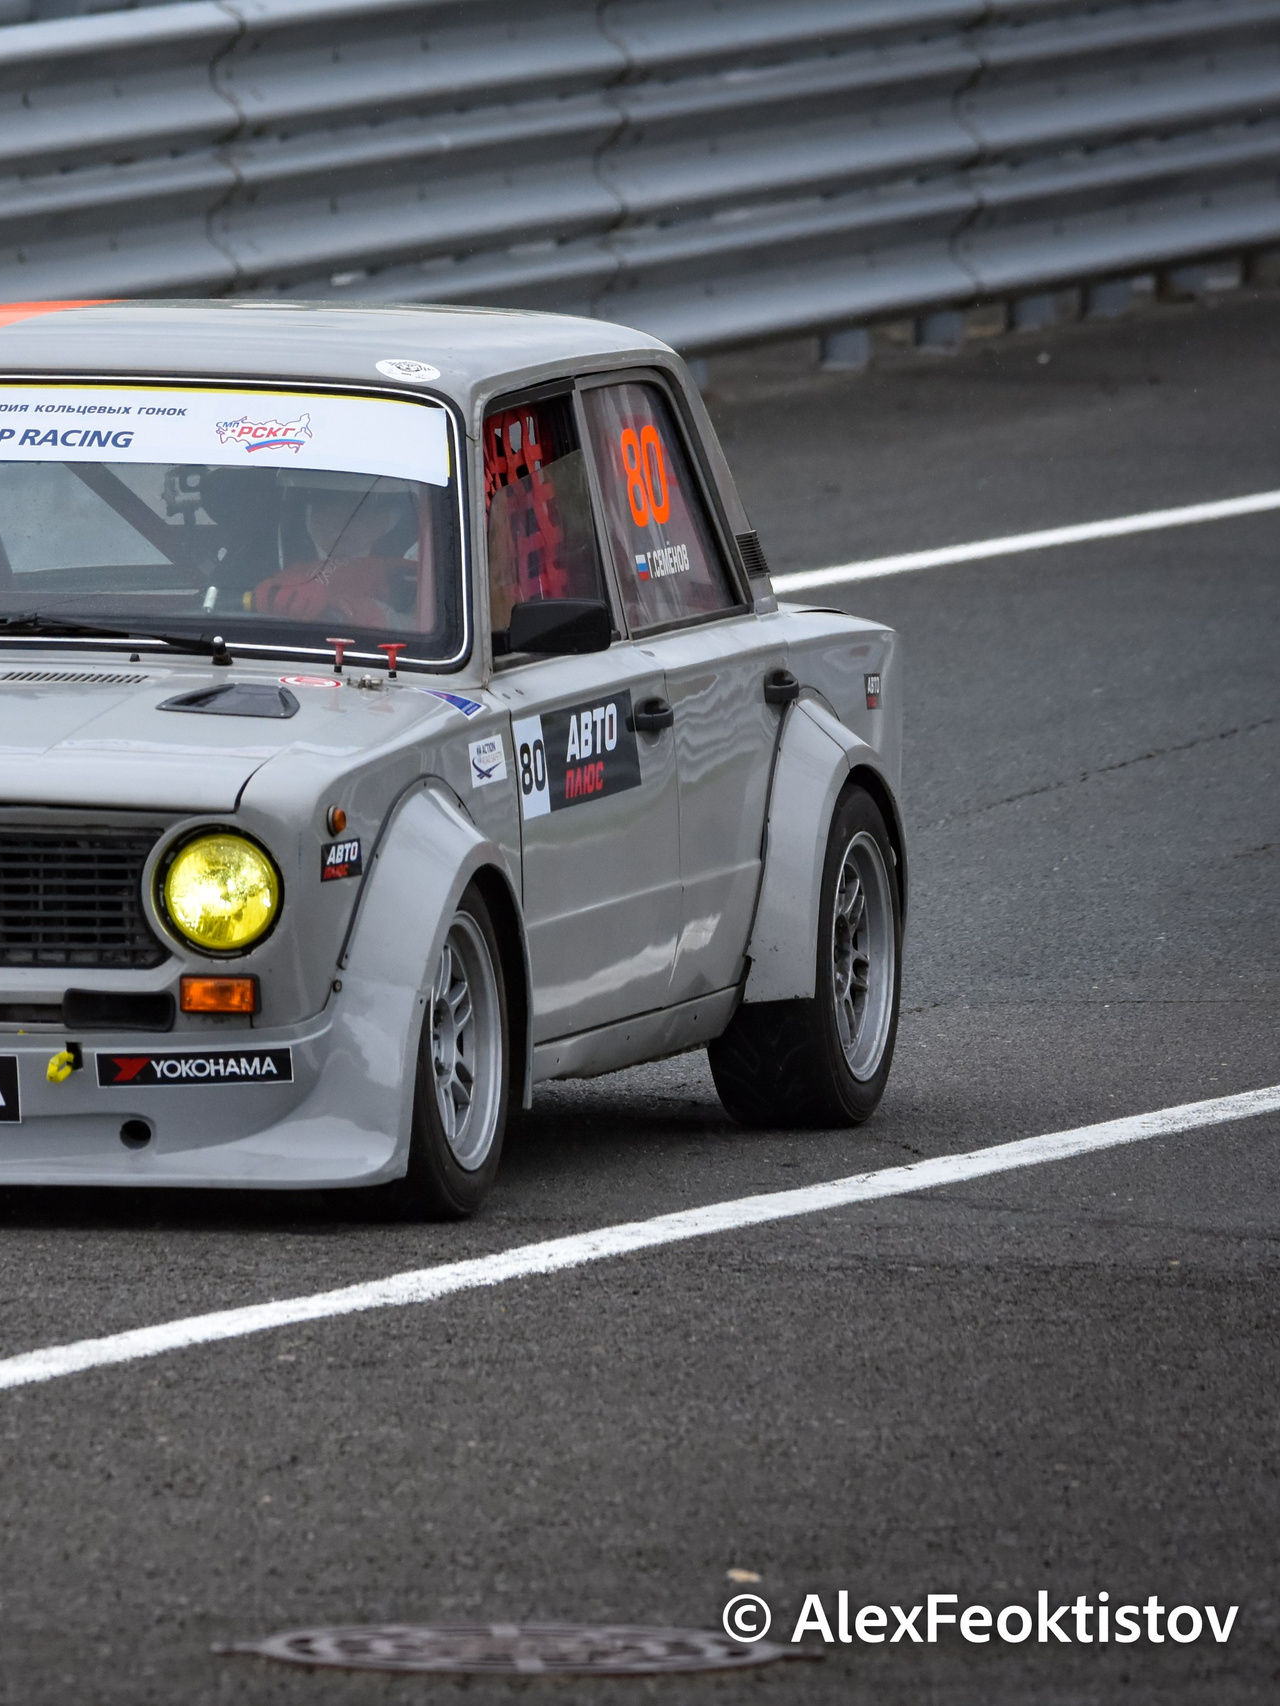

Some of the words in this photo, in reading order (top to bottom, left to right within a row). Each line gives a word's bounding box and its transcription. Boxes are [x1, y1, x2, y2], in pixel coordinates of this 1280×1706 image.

[34, 402, 131, 415] кольцевых
[137, 405, 188, 416] гонок
[18, 429, 135, 448] RACING
[237, 426, 296, 438] РСКГ
[621, 425, 670, 527] 80
[566, 702, 617, 763] АВТО
[520, 739, 546, 795] 80
[565, 761, 604, 799] ПЛЮС
[326, 841, 359, 866] АВТО
[150, 1057, 277, 1078] YOKOHAMA
